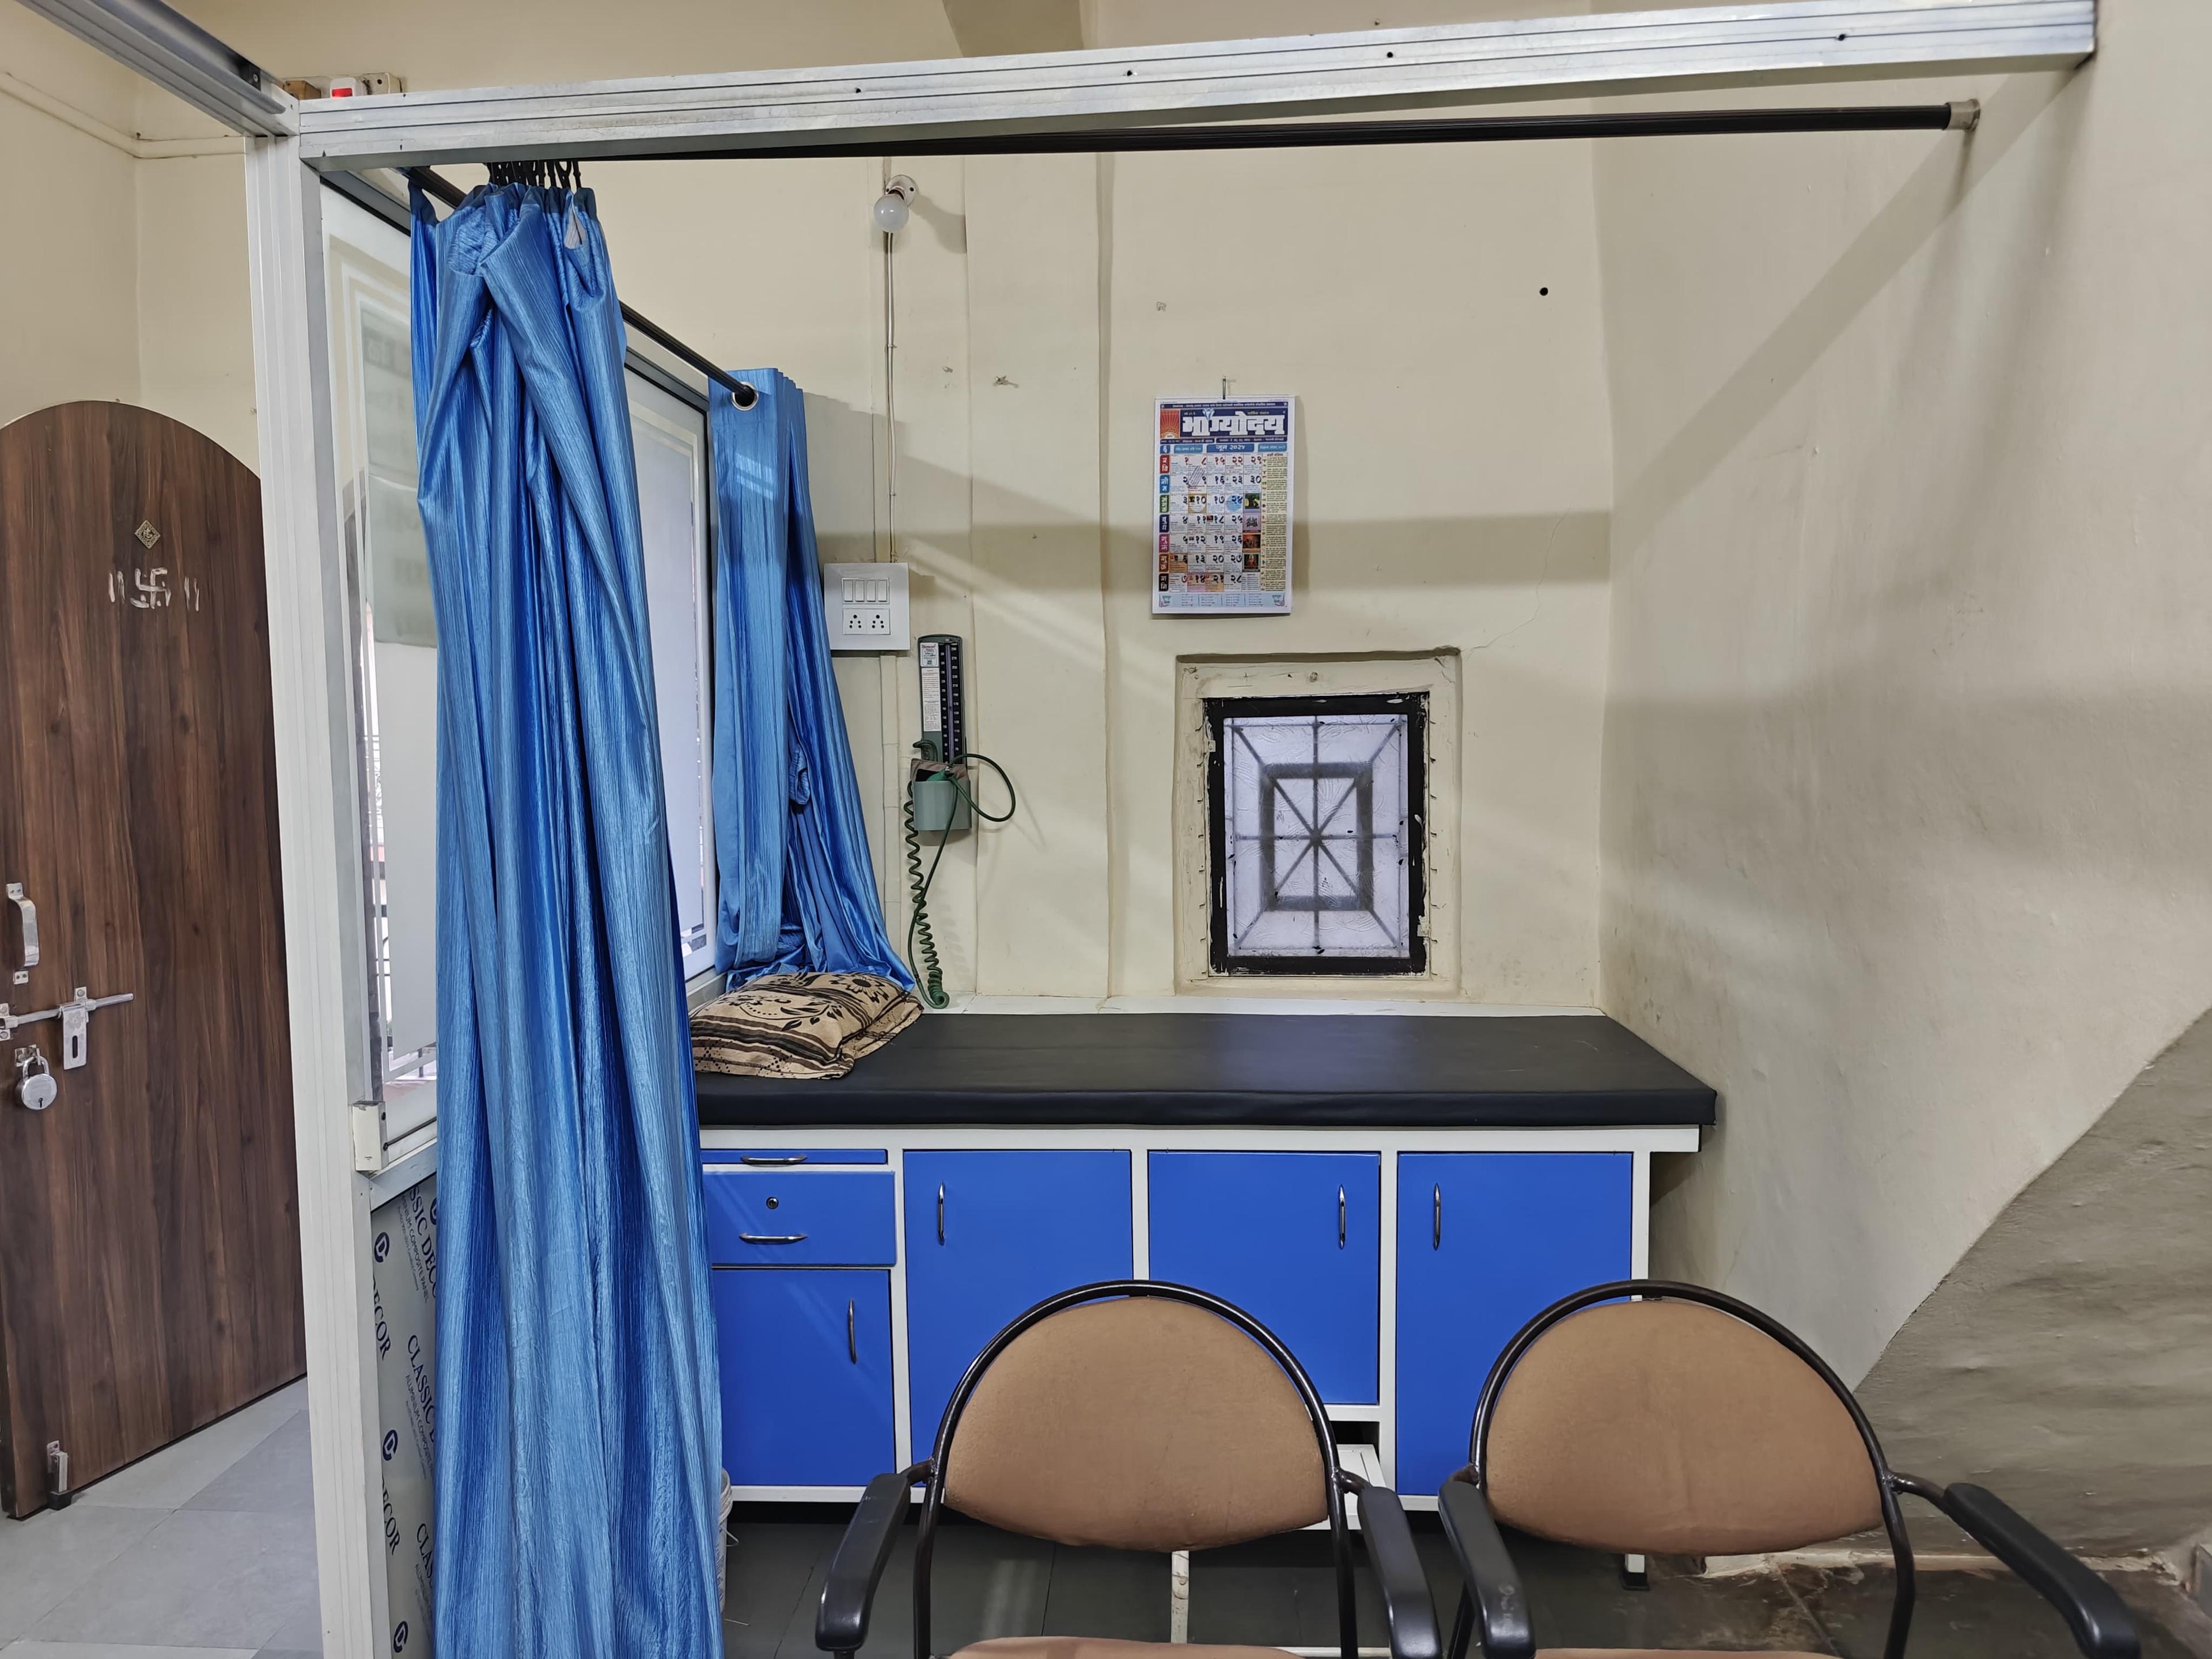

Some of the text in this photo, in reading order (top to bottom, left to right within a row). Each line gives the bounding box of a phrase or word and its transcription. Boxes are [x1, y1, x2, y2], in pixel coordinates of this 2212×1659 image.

[1215, 457, 1225, 465] १५
[1232, 457, 1243, 465] २२
[1251, 456, 1262, 465] २९
[1214, 476, 1225, 484] १६
[1251, 476, 1261, 484] ३०
[1214, 496, 1225, 504] १७
[1232, 496, 1243, 504] २४
[1197, 516, 1206, 524] ११
[1214, 516, 1224, 524] १८
[1232, 516, 1243, 524] २५
[1196, 536, 1206, 544] १२
[1214, 536, 1224, 544] १९
[1232, 536, 1242, 544] २६
[1195, 555, 1206, 563] १३
[1231, 555, 1242, 563] २७
[1195, 575, 1205, 584] १४
[410, 1187, 428, 1236] SSIC
[409, 1228, 422, 1278] COMPOSITE
